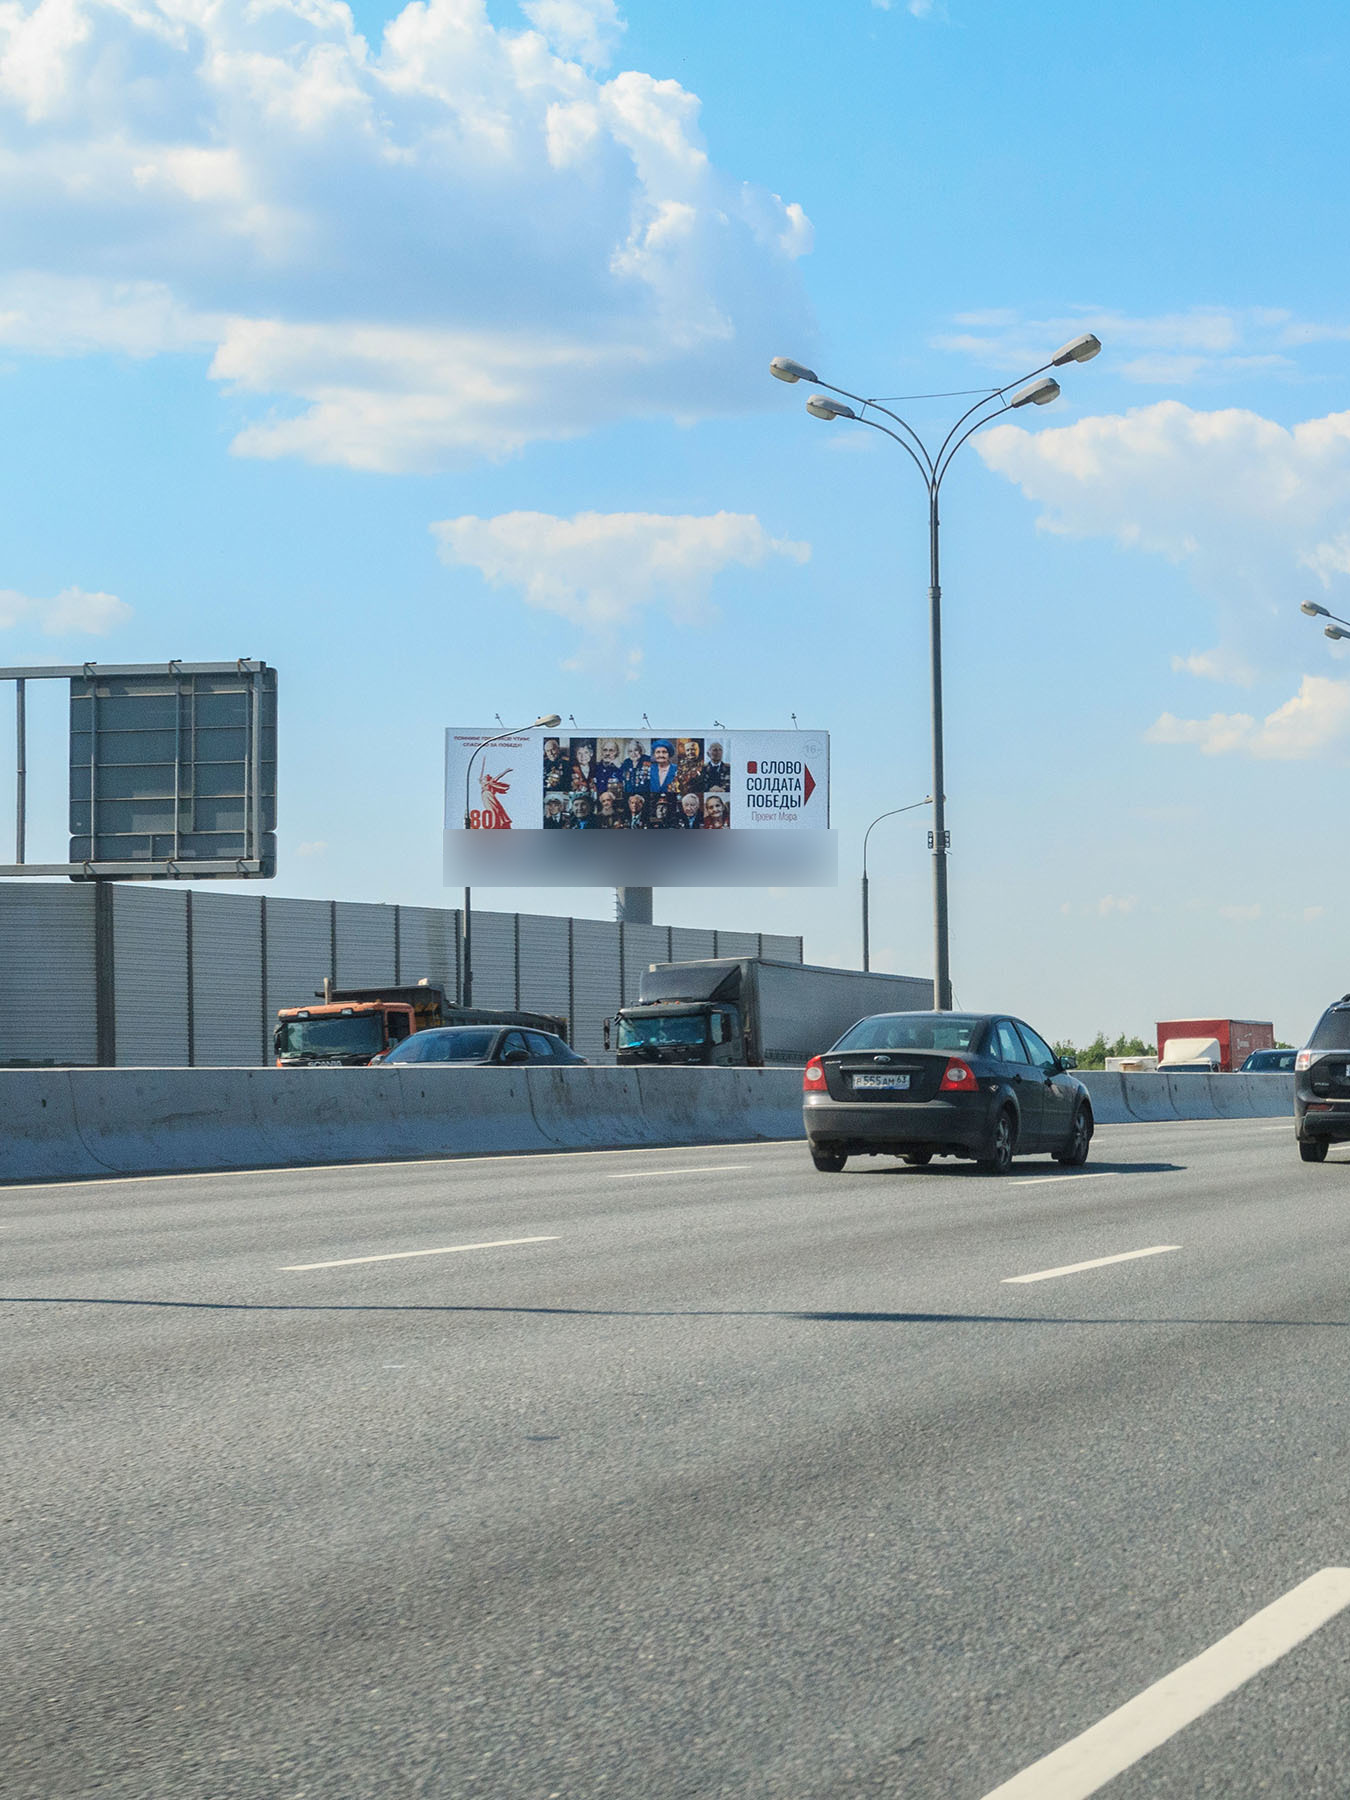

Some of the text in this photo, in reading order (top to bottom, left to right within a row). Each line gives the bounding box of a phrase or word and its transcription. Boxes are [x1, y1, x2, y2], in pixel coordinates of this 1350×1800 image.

[760, 760, 802, 775] СЛОВО
[746, 777, 802, 793] СОЛДАТА
[747, 794, 802, 810] ПОБЕДЫ
[469, 809, 493, 829] 80
[751, 810, 798, 822] Проект Мэра
